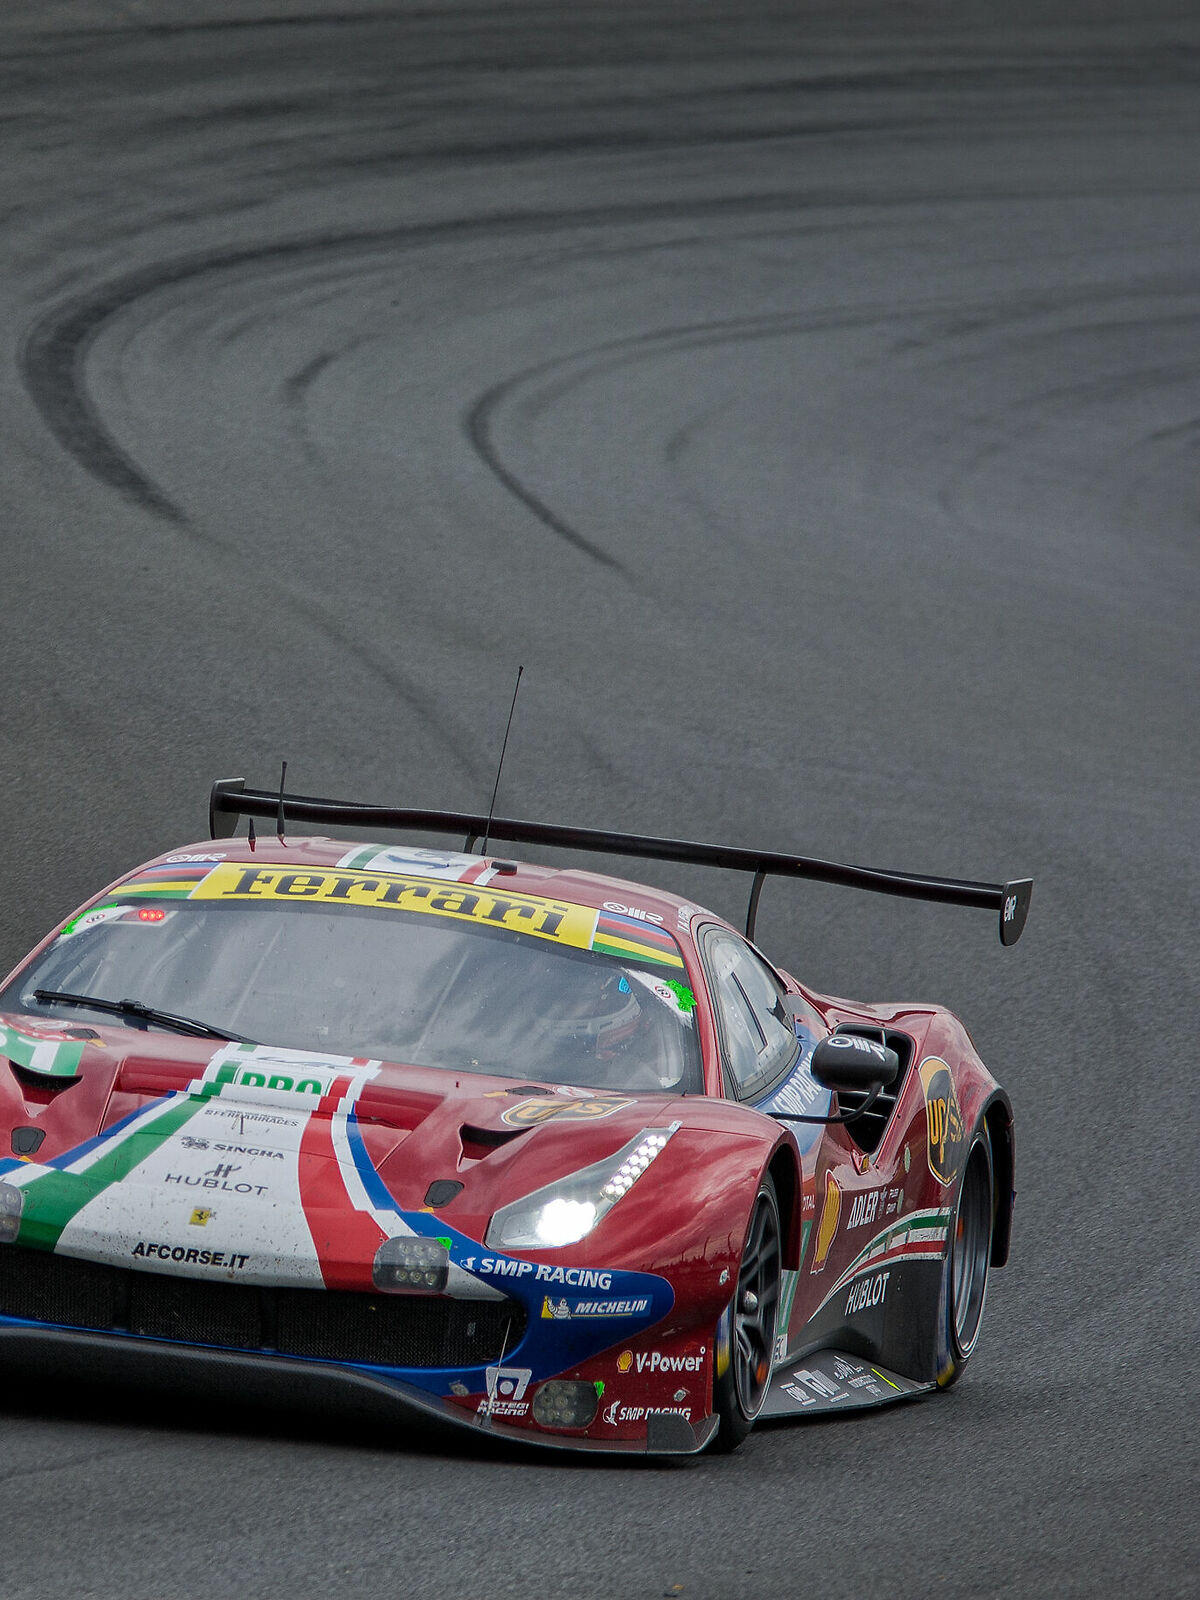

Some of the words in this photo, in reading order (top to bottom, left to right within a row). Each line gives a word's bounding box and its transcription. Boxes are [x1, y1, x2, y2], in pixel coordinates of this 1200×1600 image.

[222, 868, 568, 937] Ferrari
[212, 1143, 285, 1160] SINGHA
[164, 1173, 269, 1196] HUBLOT
[846, 1190, 879, 1230] ADLER
[131, 1241, 250, 1269] AFCORSE.IT
[479, 1258, 533, 1278] SMP
[535, 1263, 612, 1290] RACING
[844, 1272, 891, 1316] HUBLOT
[574, 1299, 648, 1315] MICHELIN
[635, 1352, 704, 1373] V-Power
[618, 1407, 645, 1421] SMP
